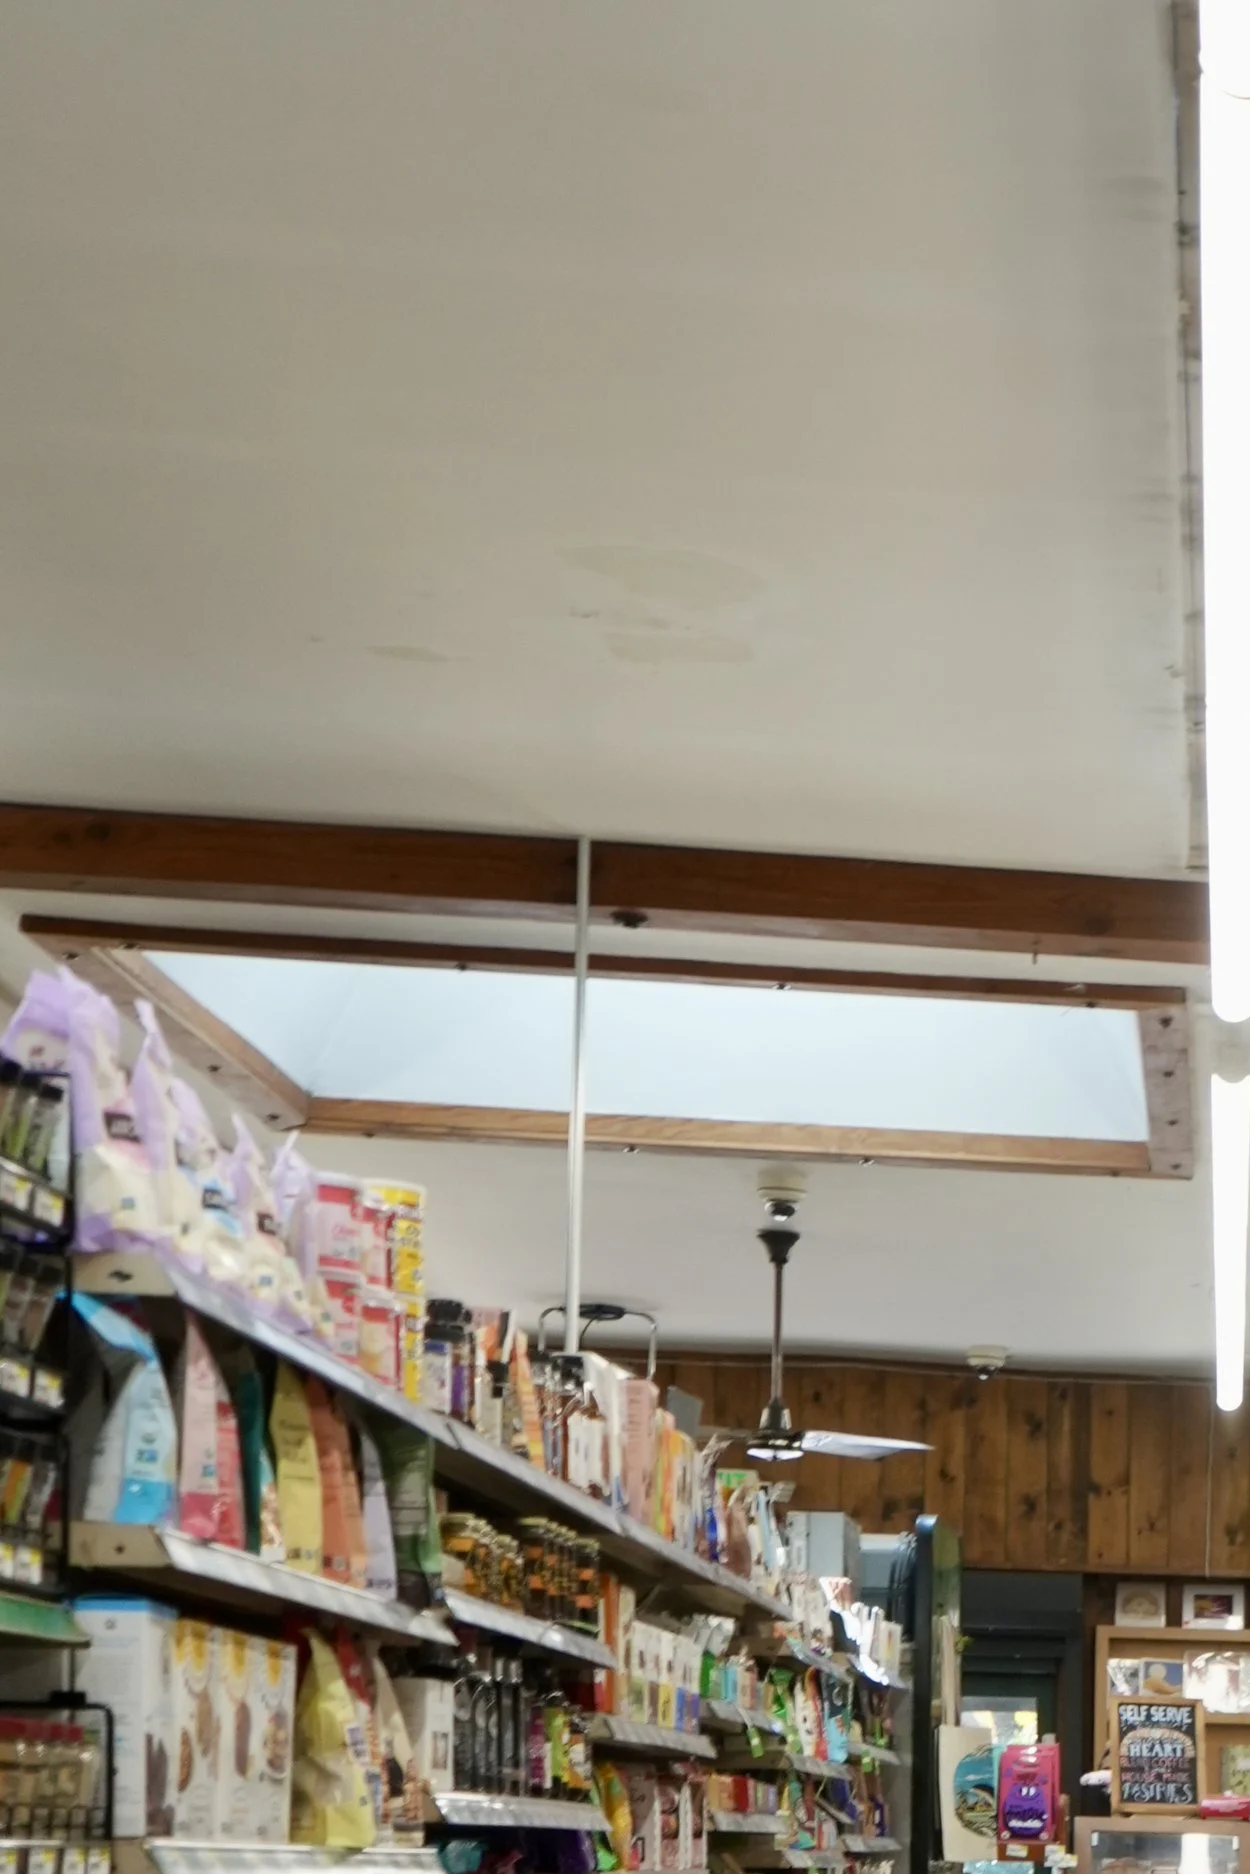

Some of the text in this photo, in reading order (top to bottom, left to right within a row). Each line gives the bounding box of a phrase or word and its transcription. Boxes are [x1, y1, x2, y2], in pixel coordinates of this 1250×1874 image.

[1119, 1704, 1192, 1725] SELF SERVE
[1130, 1742, 1184, 1758] HEART
